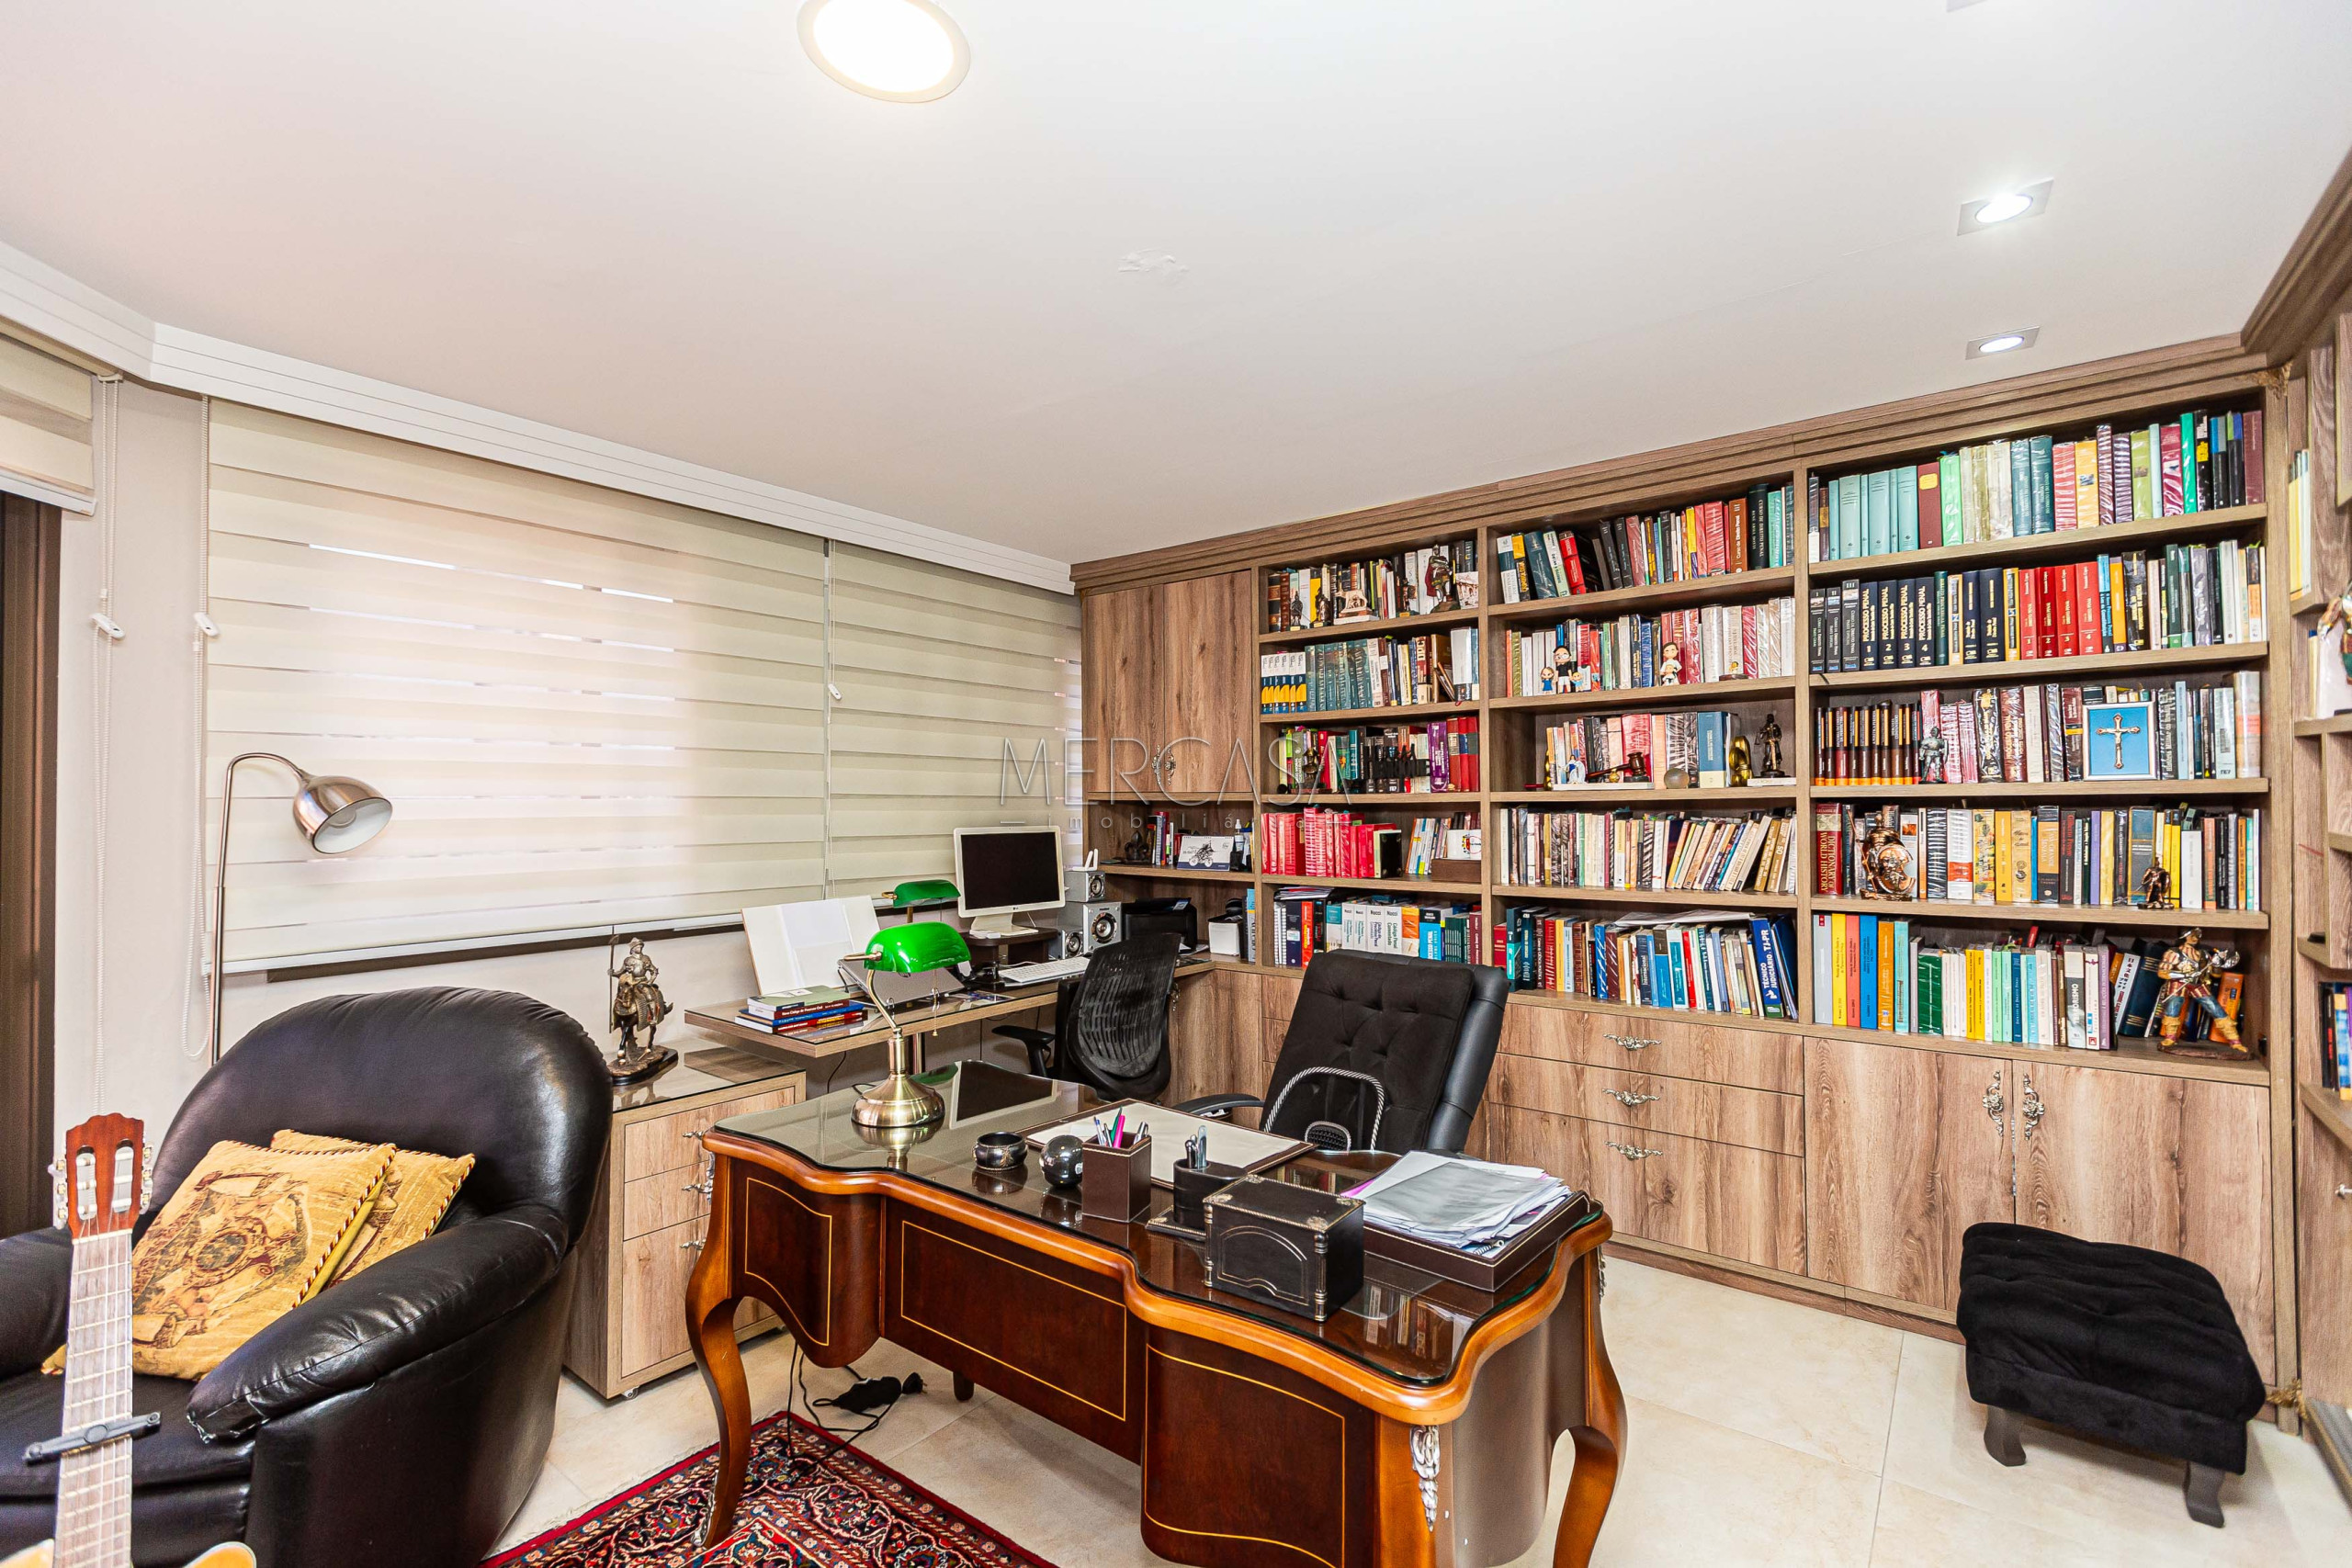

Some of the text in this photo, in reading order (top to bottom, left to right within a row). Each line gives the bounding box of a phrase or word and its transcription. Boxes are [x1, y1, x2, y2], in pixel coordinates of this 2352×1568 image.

[1776, 846, 1783, 854] OS
[1820, 860, 1828, 892] HISTORY
[1761, 930, 1777, 988] JUDICIÁRIO TJ-PR
[1760, 963, 1769, 988] TÉCNICO
[2071, 983, 2079, 1024] TERRORISMO
